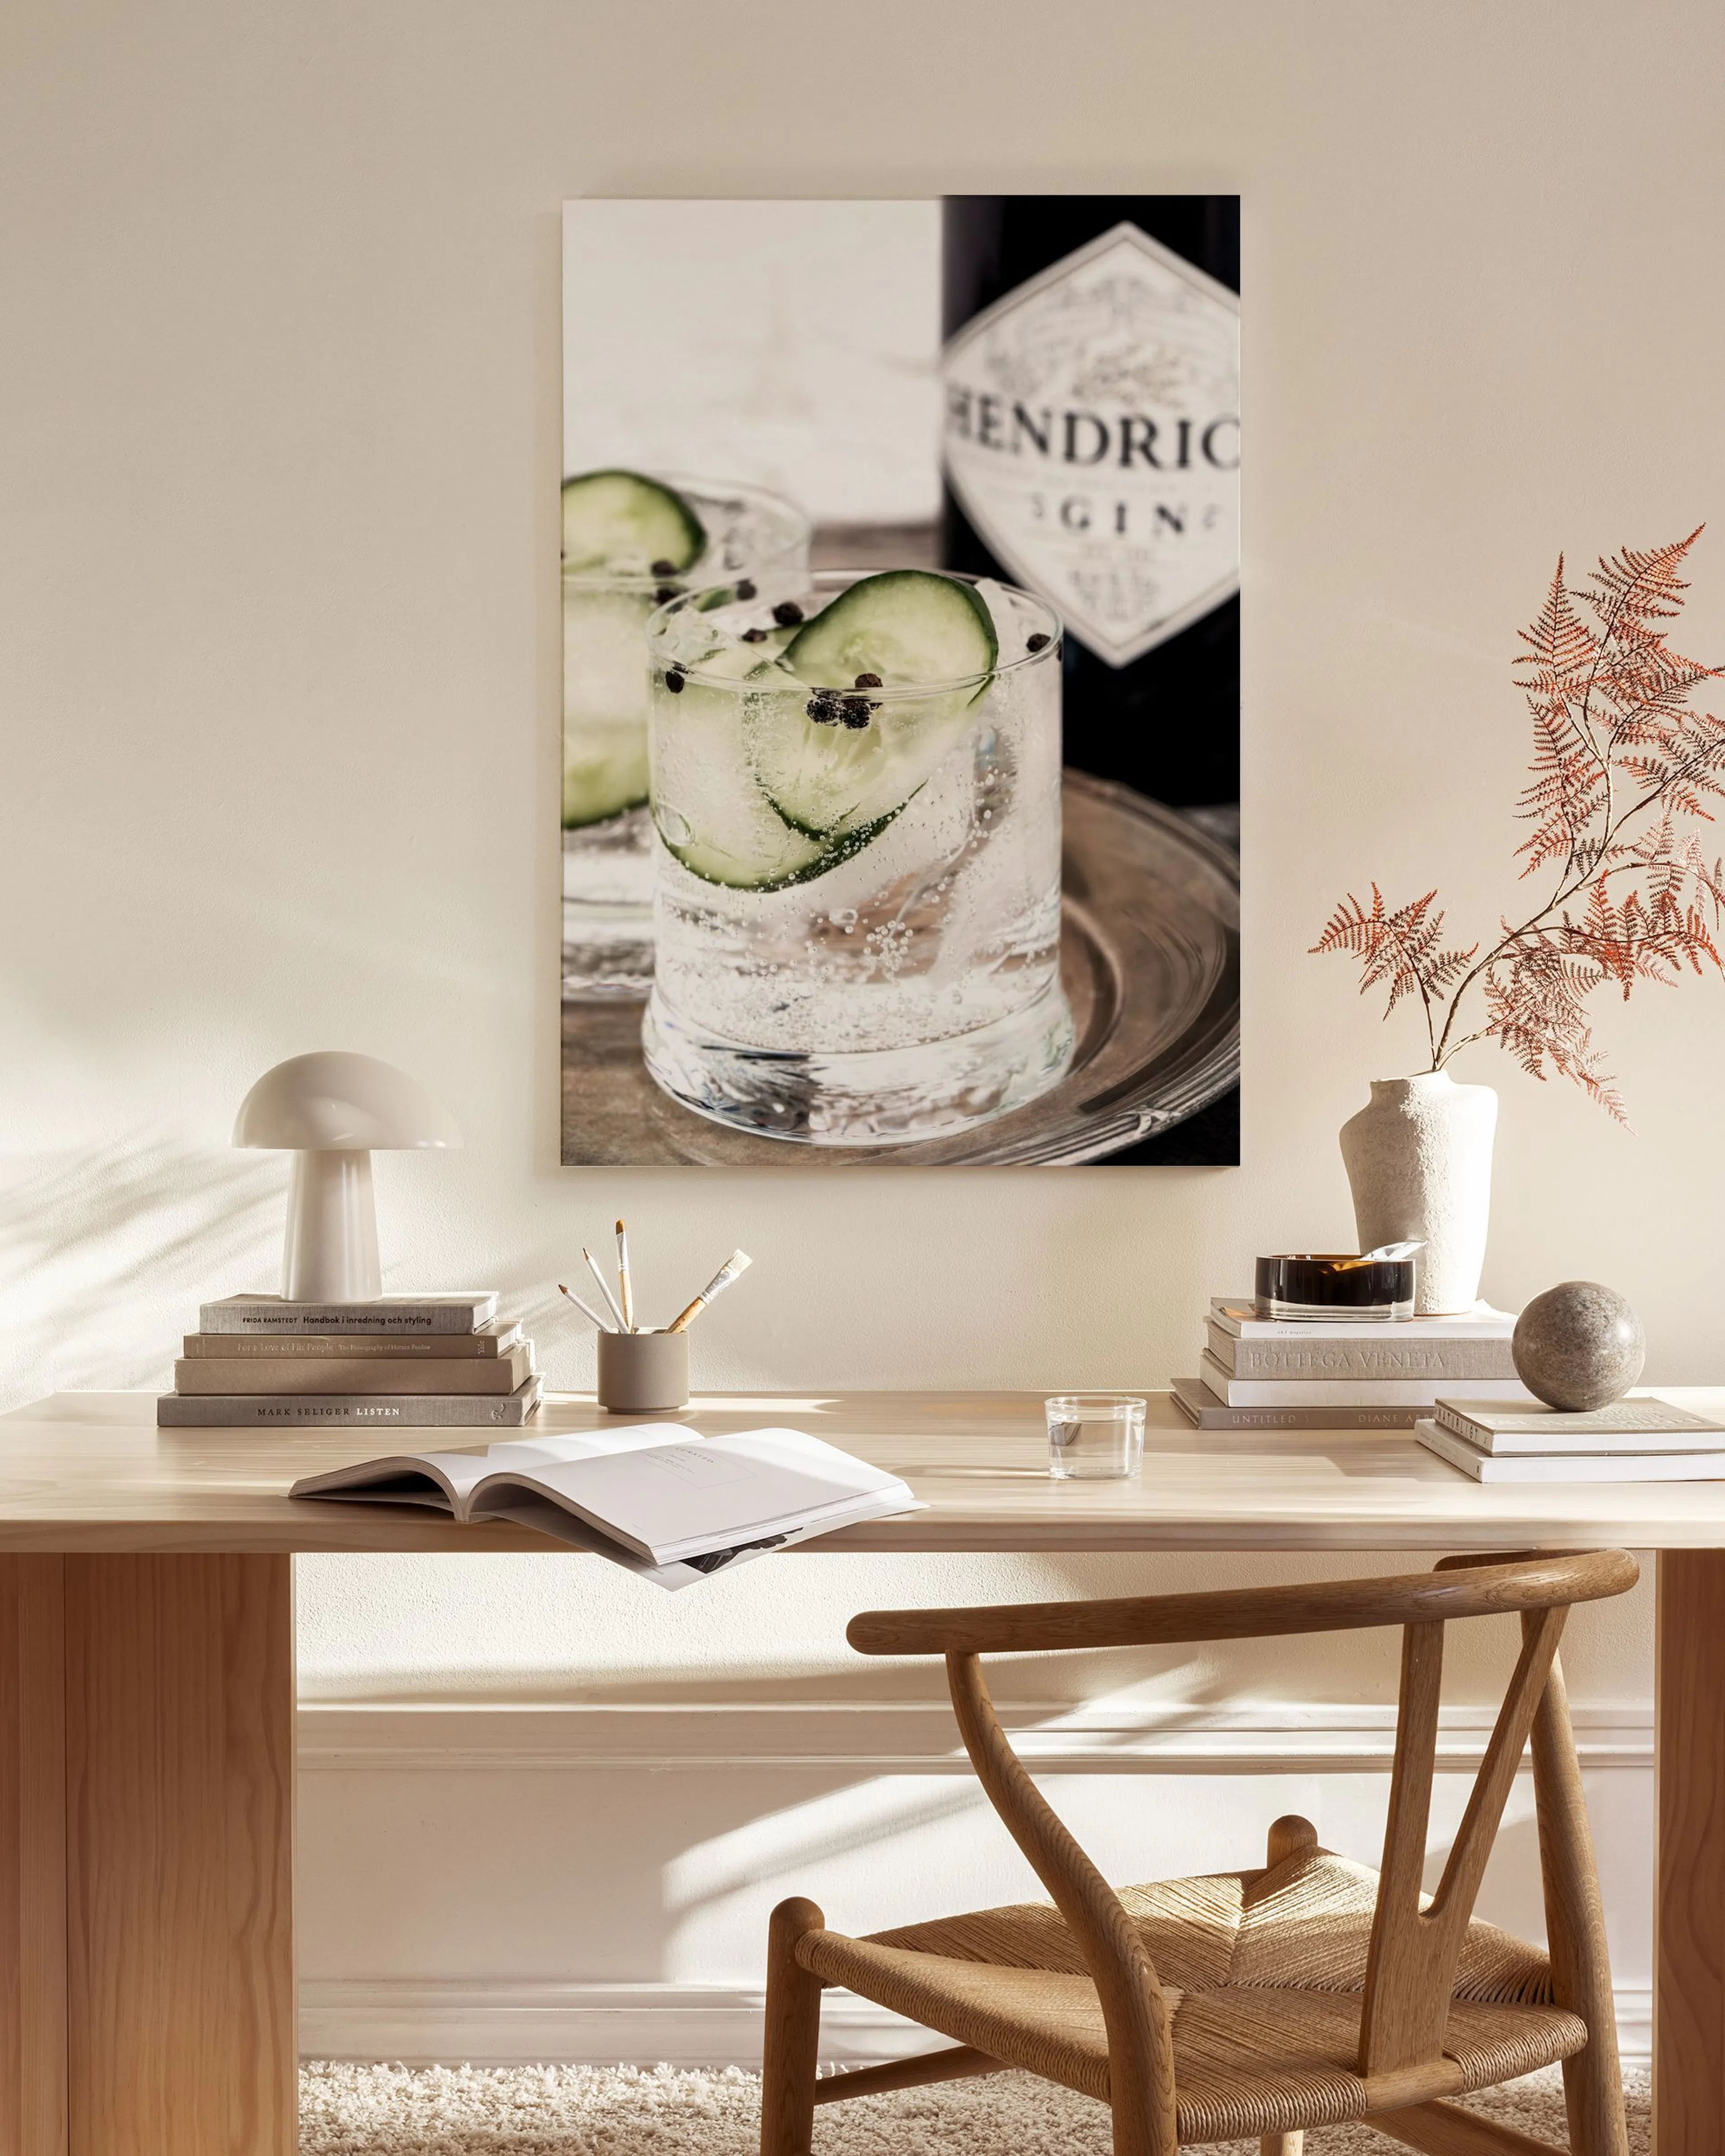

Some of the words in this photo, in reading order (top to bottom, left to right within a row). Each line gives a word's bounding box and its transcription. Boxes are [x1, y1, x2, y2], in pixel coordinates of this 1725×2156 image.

[1060, 495, 1187, 537] GIN
[346, 1317, 385, 1325] inredning
[405, 1317, 432, 1325] styling
[1250, 1352, 1351, 1367] BOTTEGA
[1359, 1352, 1445, 1367] VENETA
[1232, 1415, 1296, 1423] UNTITLED
[1358, 1414, 1398, 1423] DIANE
